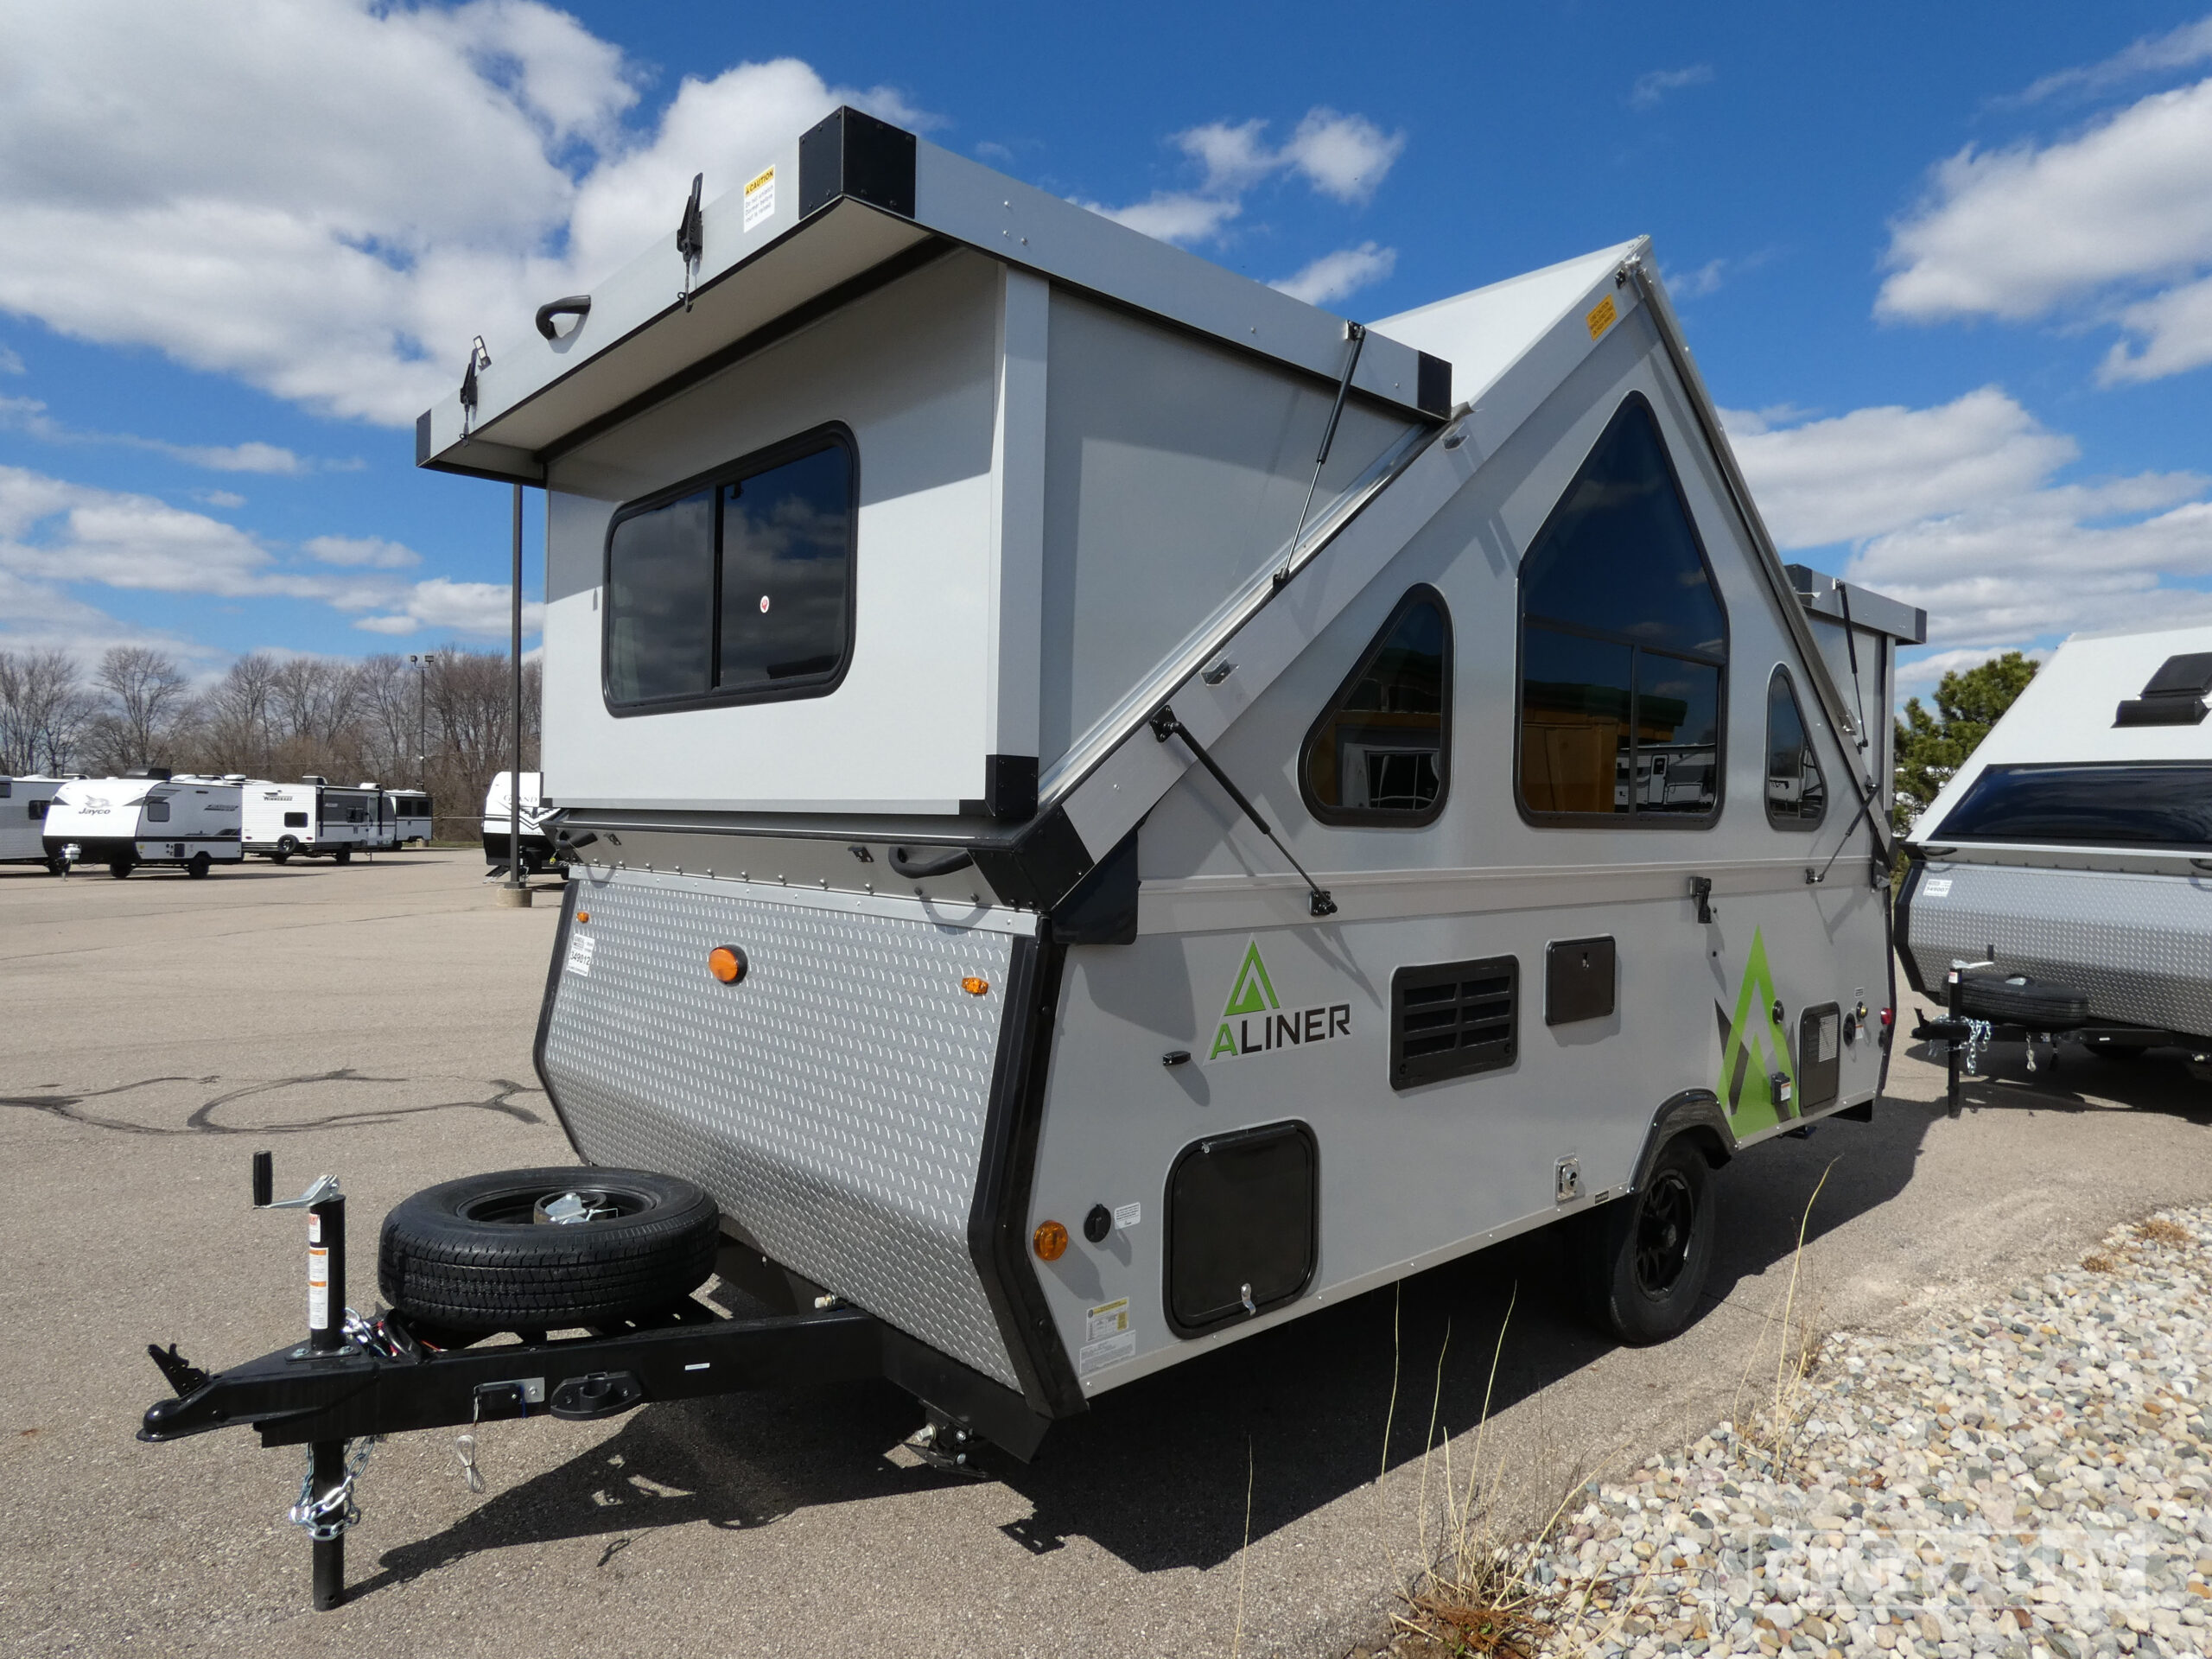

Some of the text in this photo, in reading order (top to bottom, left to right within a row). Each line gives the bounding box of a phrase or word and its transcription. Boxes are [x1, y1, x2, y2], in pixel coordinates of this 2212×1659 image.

[750, 170, 773, 191] CAUTION
[570, 951, 590, 965] 349012
[1210, 1003, 1351, 1060] ALINER
